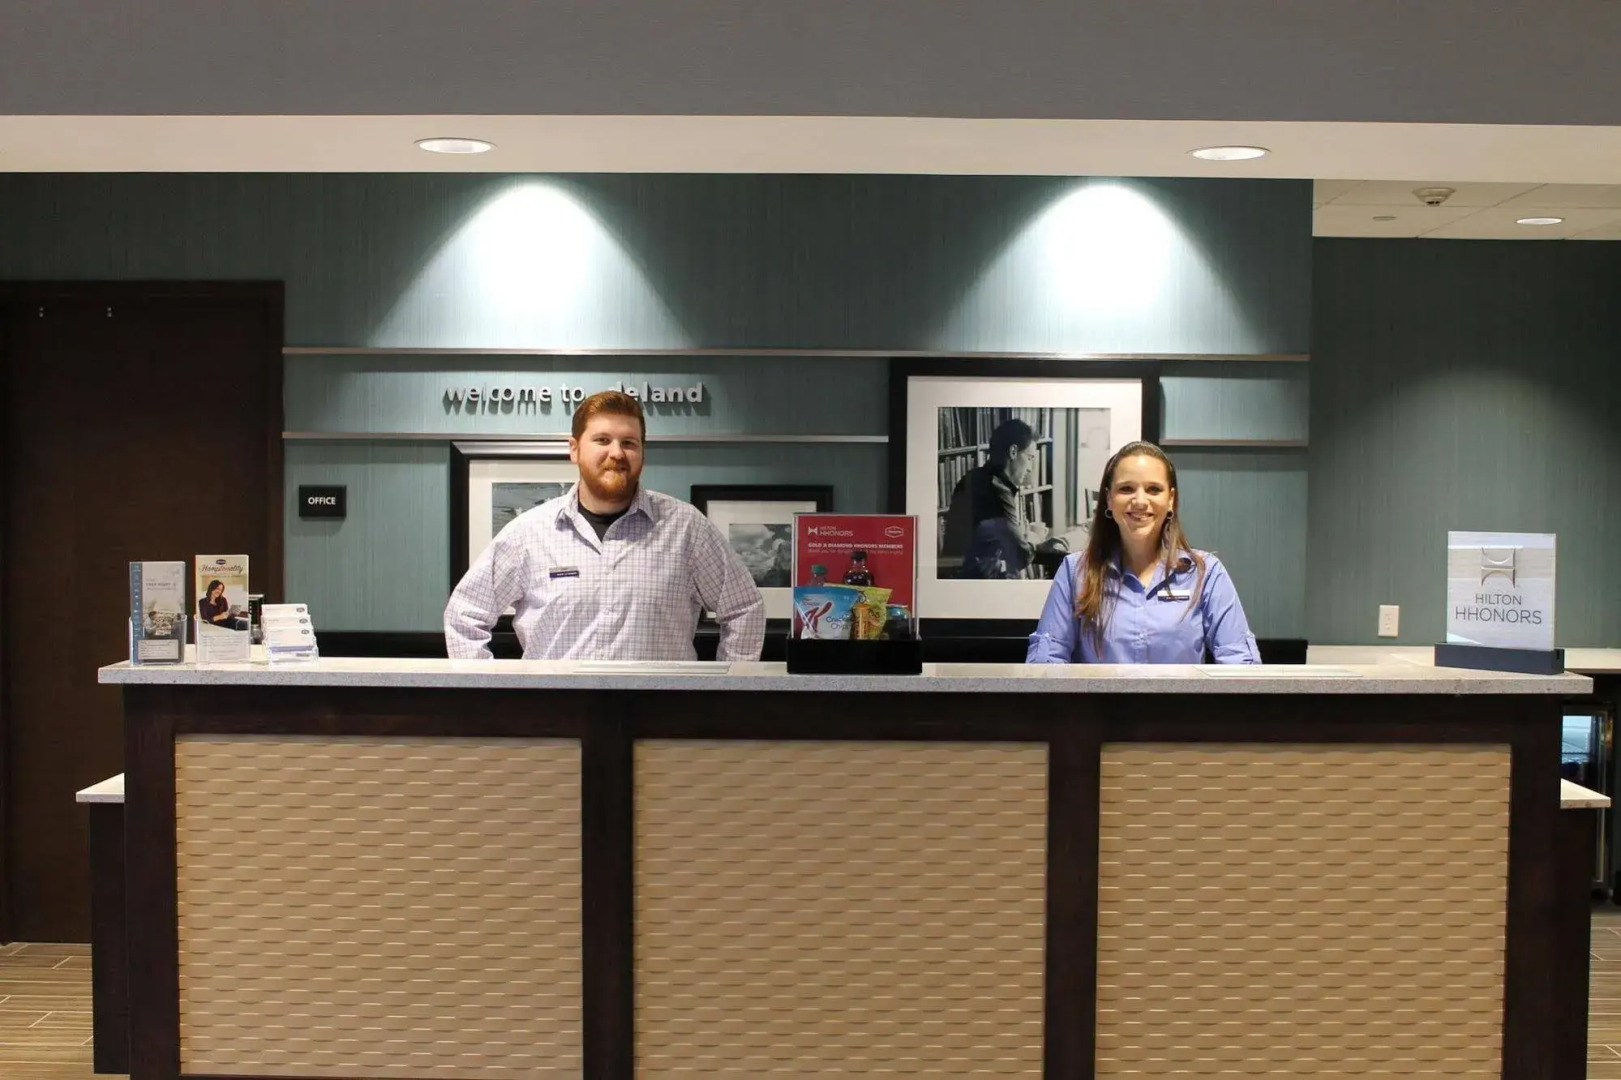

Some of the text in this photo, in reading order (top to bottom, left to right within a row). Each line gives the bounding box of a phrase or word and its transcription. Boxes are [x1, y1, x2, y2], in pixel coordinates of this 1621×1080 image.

[445, 382, 552, 403] welcome
[560, 383, 585, 403] to
[308, 496, 336, 505] OFFICE
[1475, 593, 1522, 606] HILTON
[1455, 606, 1543, 625] HHONORS
